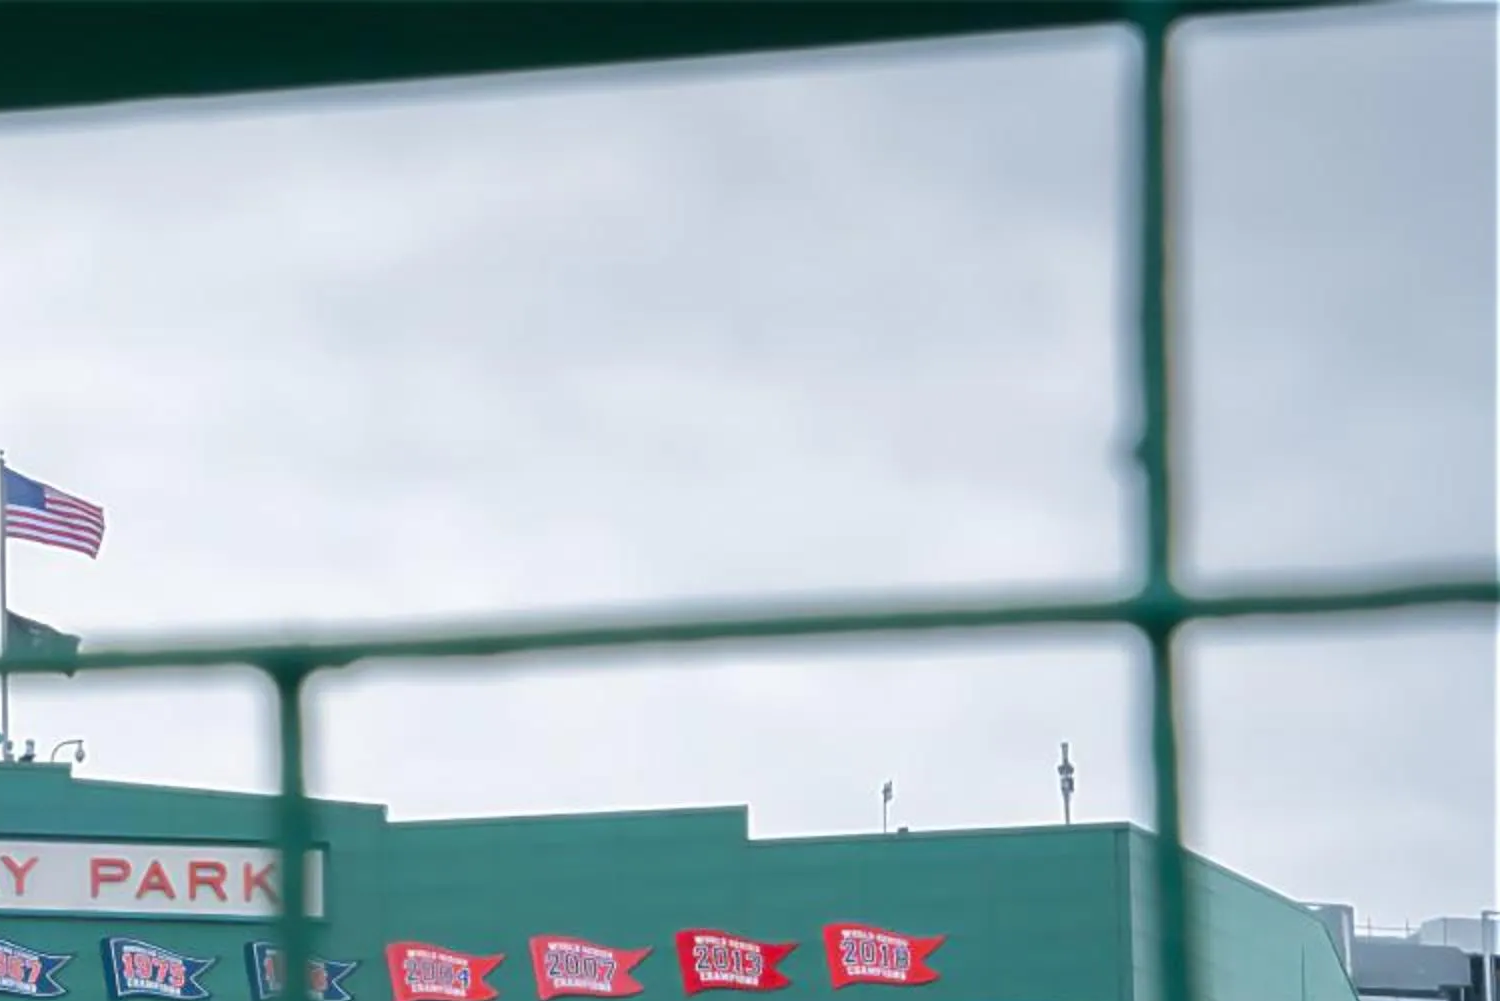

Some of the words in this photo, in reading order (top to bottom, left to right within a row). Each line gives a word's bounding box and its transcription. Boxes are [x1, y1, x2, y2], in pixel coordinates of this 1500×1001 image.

[89, 856, 284, 905] PARK
[122, 952, 185, 988] 1975
[545, 951, 616, 983] 2007
[693, 944, 763, 977] 2013
[839, 939, 911, 971] 2018
